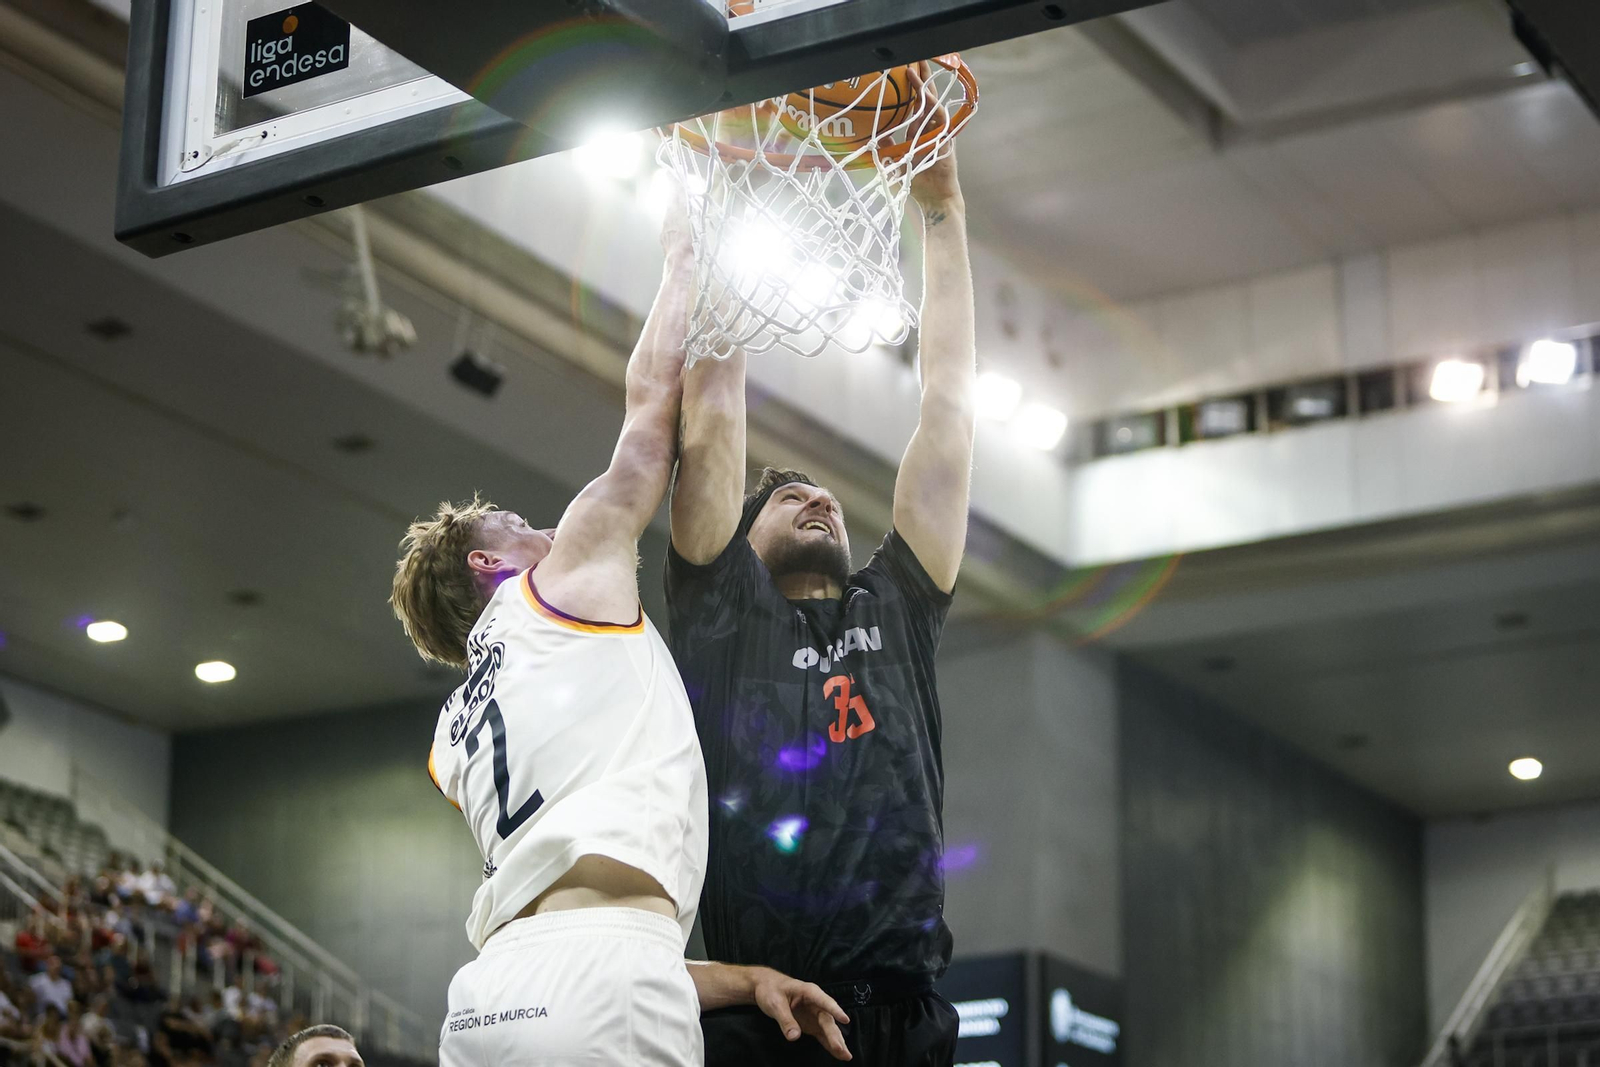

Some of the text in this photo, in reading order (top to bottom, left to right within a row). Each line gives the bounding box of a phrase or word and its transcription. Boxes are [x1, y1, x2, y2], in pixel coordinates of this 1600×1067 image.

[249, 44, 344, 87] endesa
[251, 36, 292, 64] liga
[465, 698, 545, 840] 2
[449, 1007, 548, 1033] REGIÓN DE MURCIA
